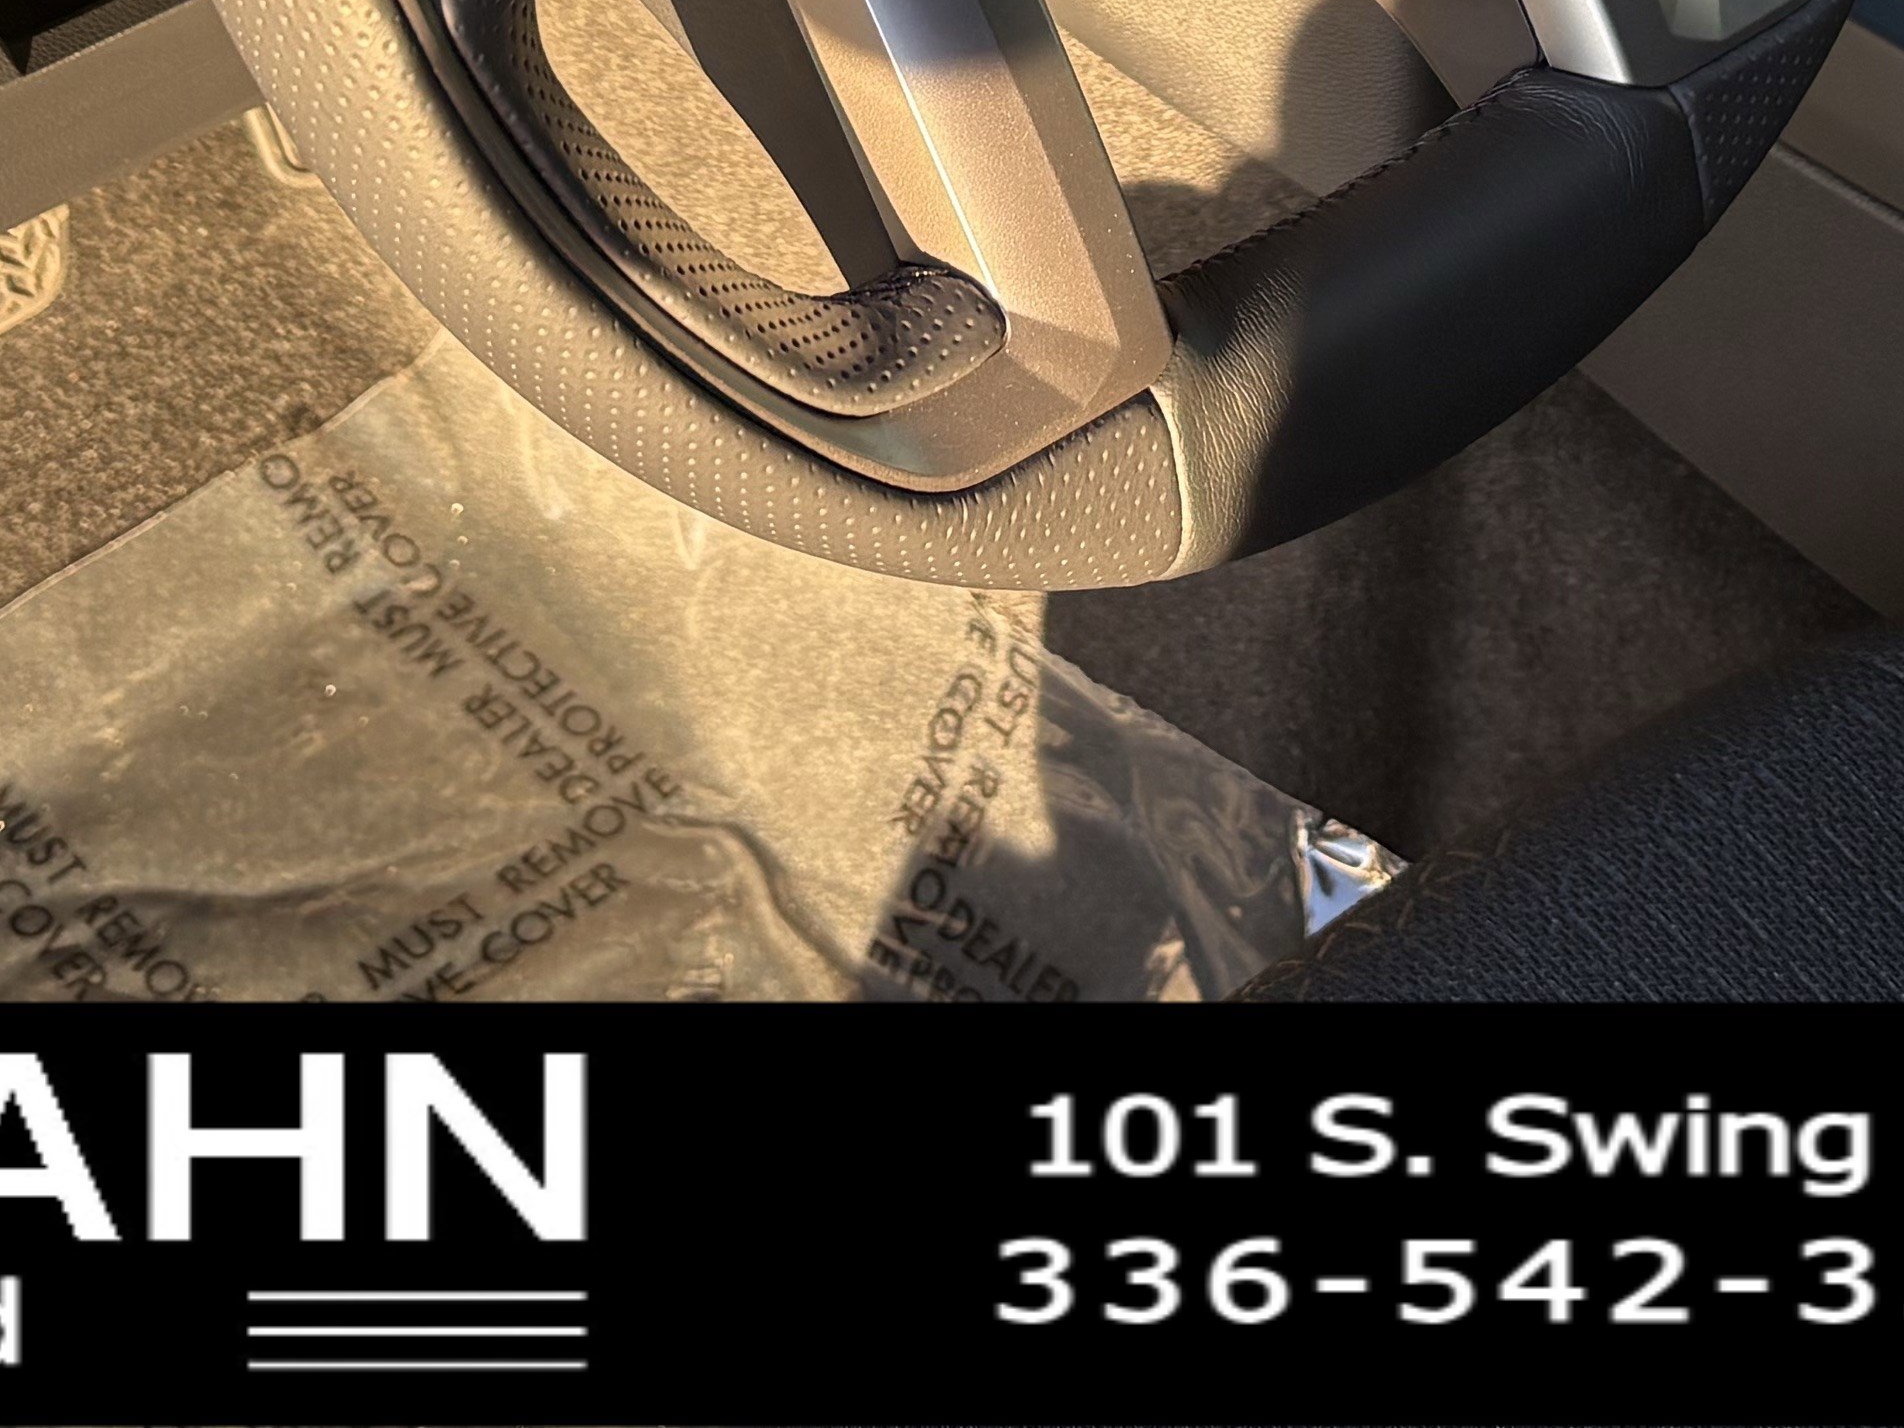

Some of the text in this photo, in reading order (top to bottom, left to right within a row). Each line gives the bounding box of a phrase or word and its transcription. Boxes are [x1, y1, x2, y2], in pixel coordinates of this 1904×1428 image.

[328, 468, 648, 775] PROTECTIVE COVER
[352, 590, 466, 678] MUST
[463, 684, 604, 805] DEALER
[983, 645, 1041, 747] UST
[357, 767, 683, 992] MUST REMOVE
[482, 860, 631, 968] COVER
